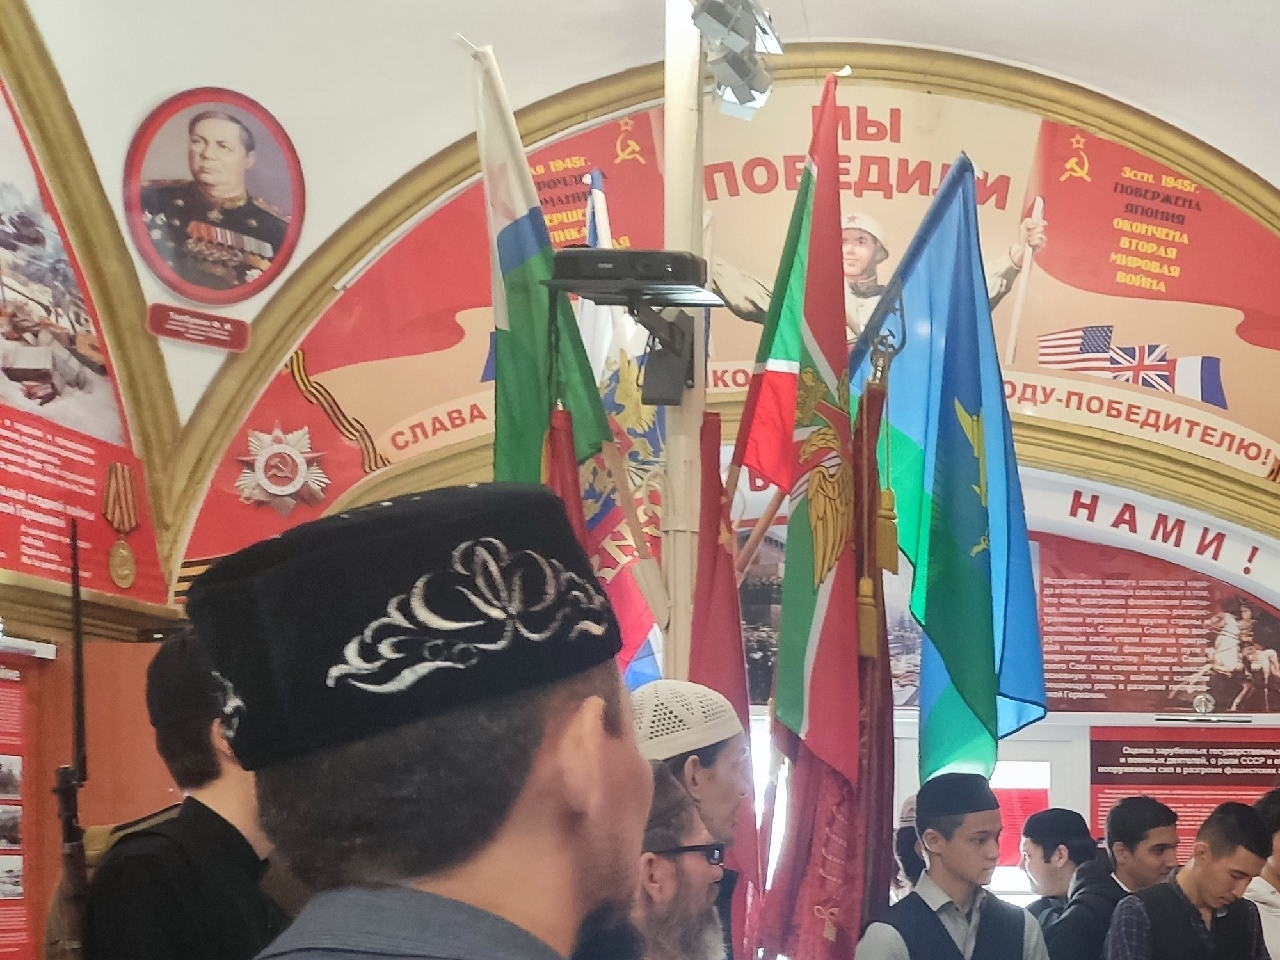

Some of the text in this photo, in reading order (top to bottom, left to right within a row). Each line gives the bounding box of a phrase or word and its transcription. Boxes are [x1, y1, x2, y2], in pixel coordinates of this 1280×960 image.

[1113, 182, 1201, 211] ПОВЕРЖЕНА
[1124, 203, 1185, 225] ЯПОНИЯ
[1113, 217, 1189, 245] ОКОНЧЕНА
[1119, 236, 1177, 259] ВТОРАЯ
[1109, 252, 1180, 278] МИРОВАЯ
[1116, 271, 1166, 292] ВОЙНА
[391, 403, 487, 451] СЛАВА
[1003, 380, 1272, 466] ОДУ-ПОБЕДИТЕЛЮ!
